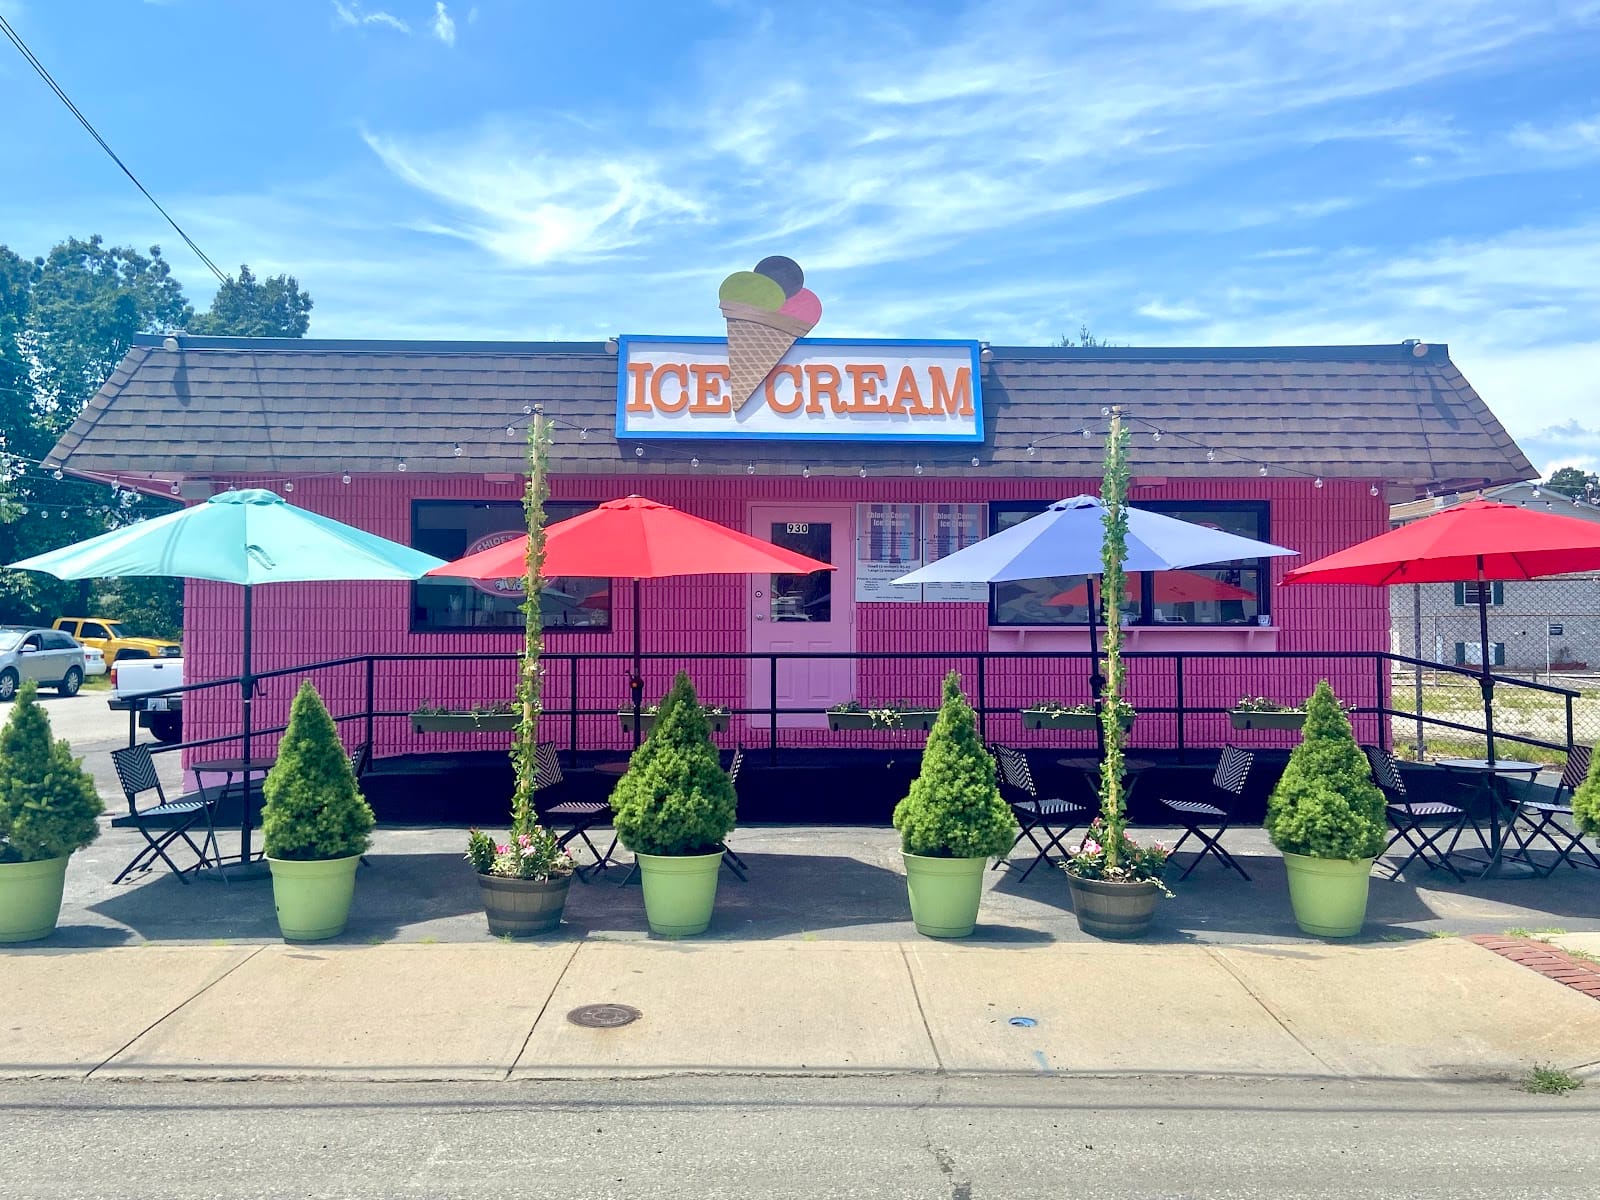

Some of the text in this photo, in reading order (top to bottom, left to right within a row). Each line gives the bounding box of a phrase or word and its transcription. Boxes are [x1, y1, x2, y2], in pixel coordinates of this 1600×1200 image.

[626, 362, 974, 416] ICE CREAM
[788, 523, 808, 533] 930
